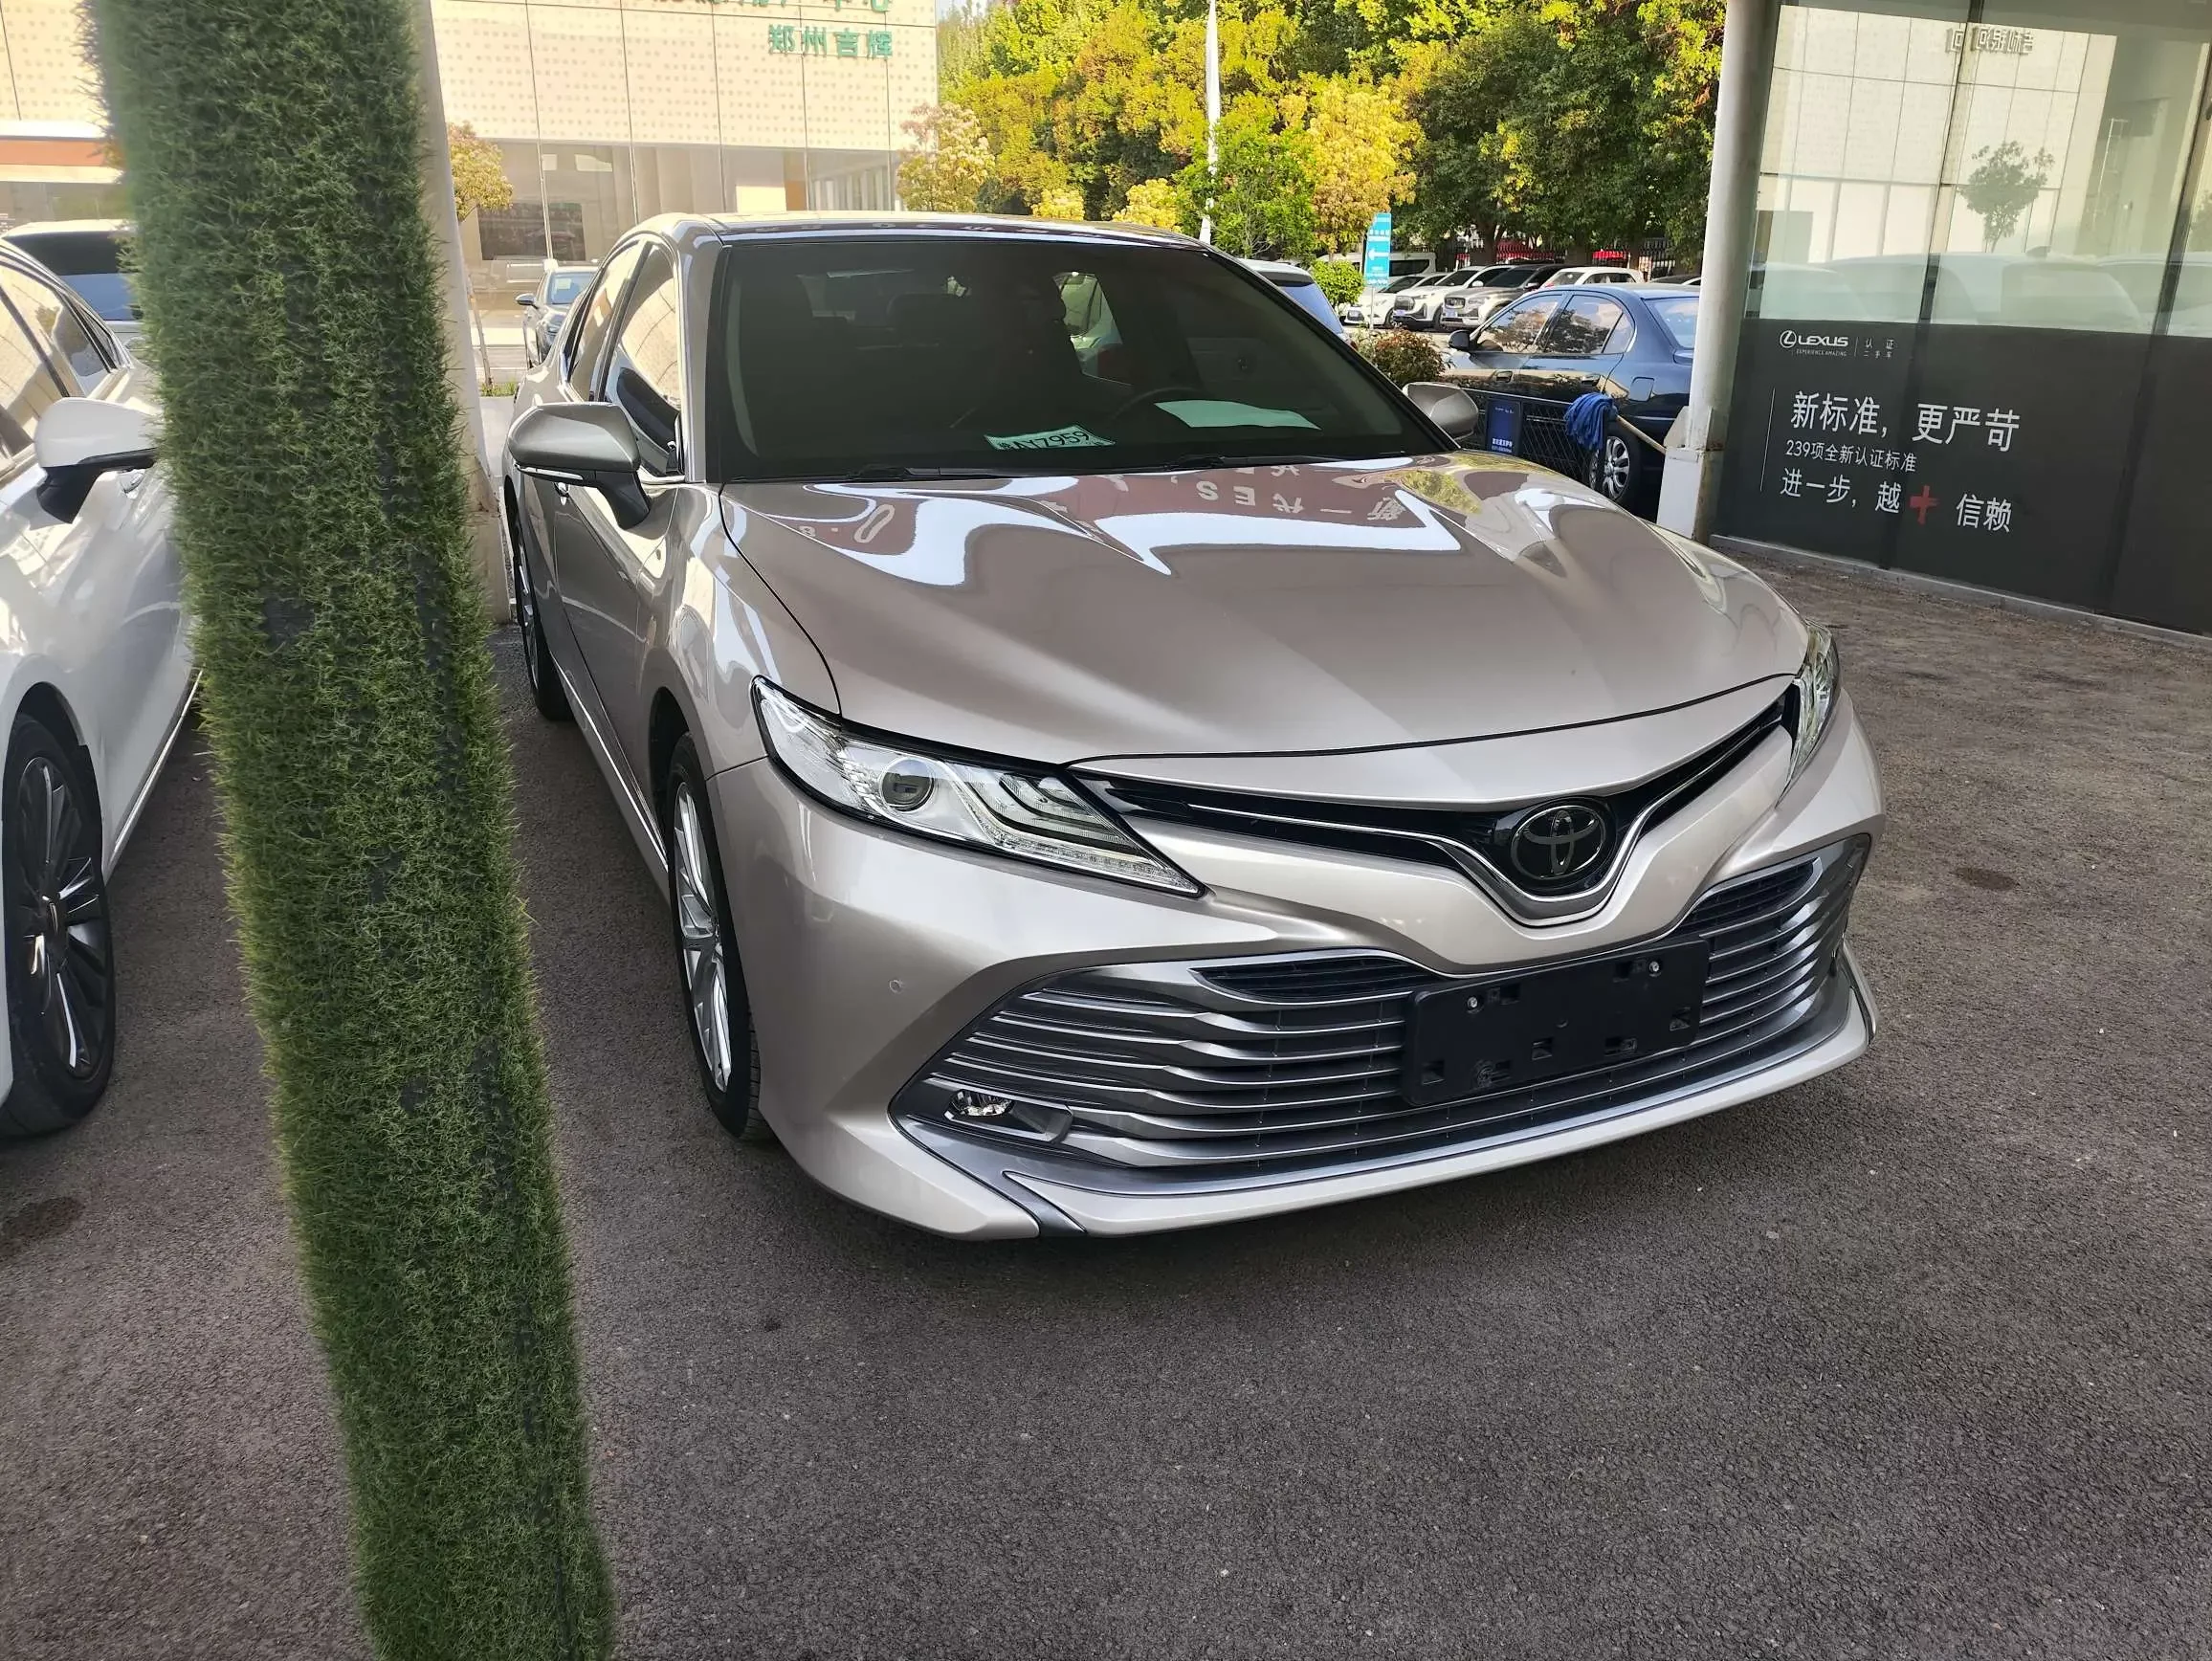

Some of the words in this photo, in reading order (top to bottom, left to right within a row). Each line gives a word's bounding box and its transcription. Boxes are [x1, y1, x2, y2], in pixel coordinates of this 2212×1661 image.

[1798, 335, 1848, 347] LEXUS
[1784, 439, 1917, 473] 239项全新认证标准
